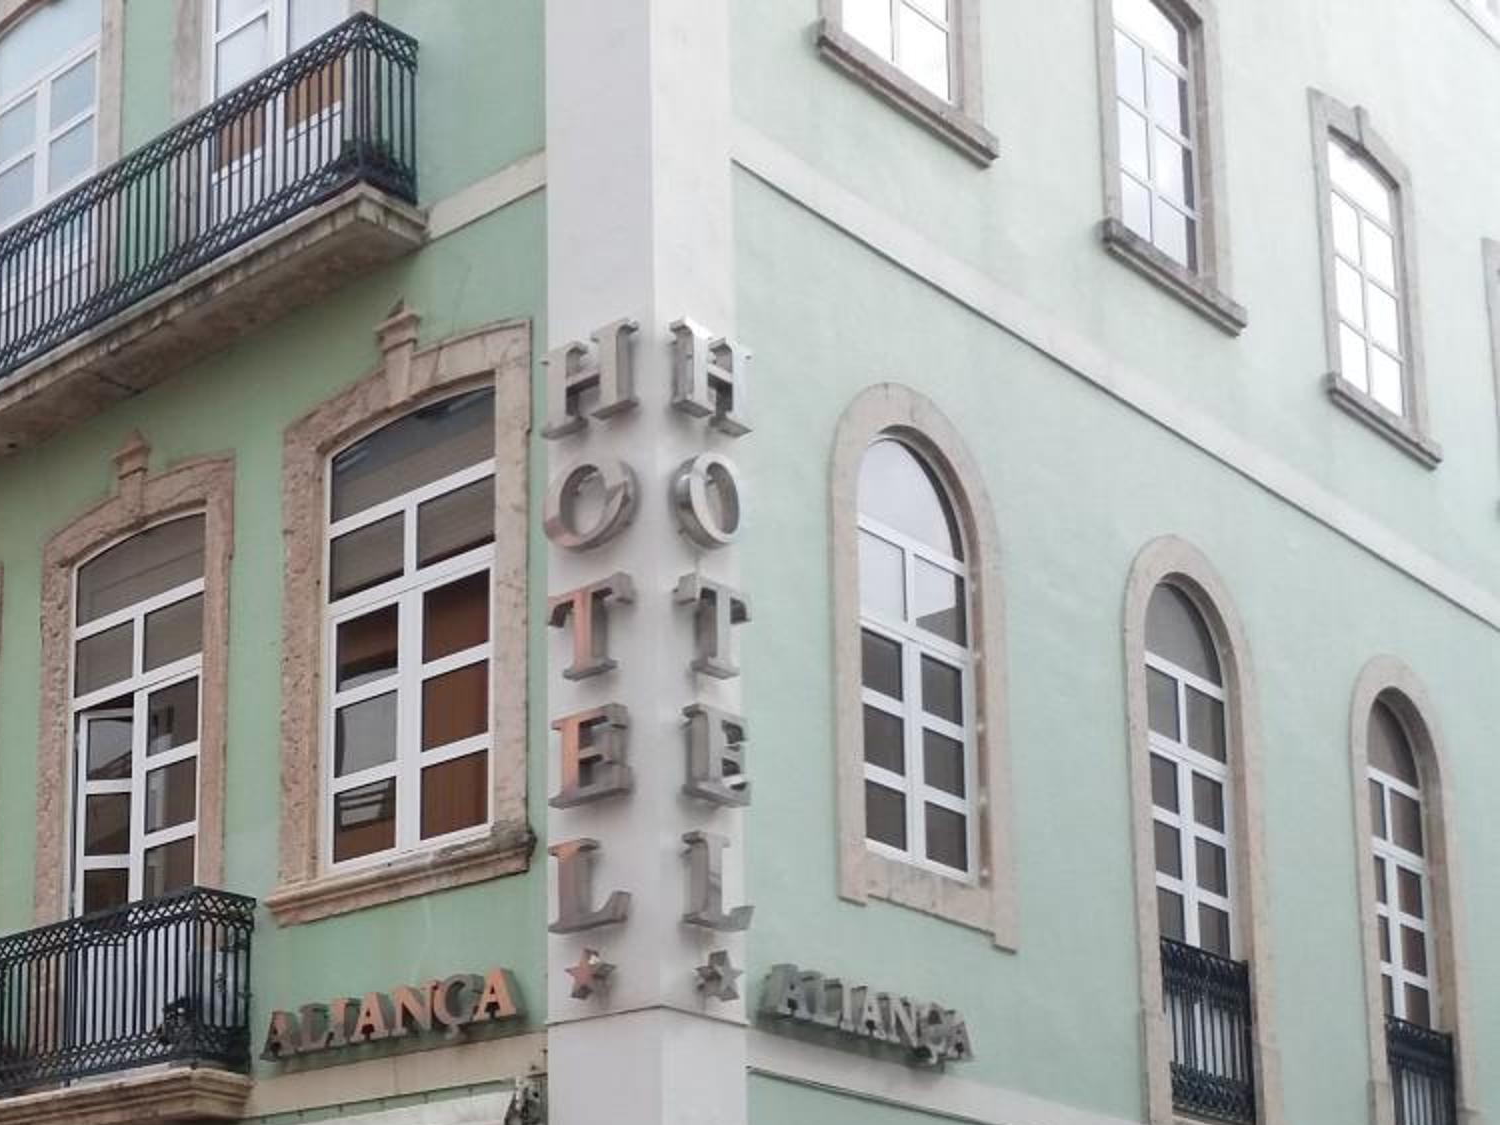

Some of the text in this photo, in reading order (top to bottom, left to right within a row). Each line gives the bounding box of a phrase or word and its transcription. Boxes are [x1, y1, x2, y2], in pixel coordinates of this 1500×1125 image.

[541, 318, 640, 933] HOTEL
[668, 316, 754, 931] HOTEL
[260, 967, 518, 1062] ALIANÇA
[764, 964, 974, 1068] ALIANÇA
